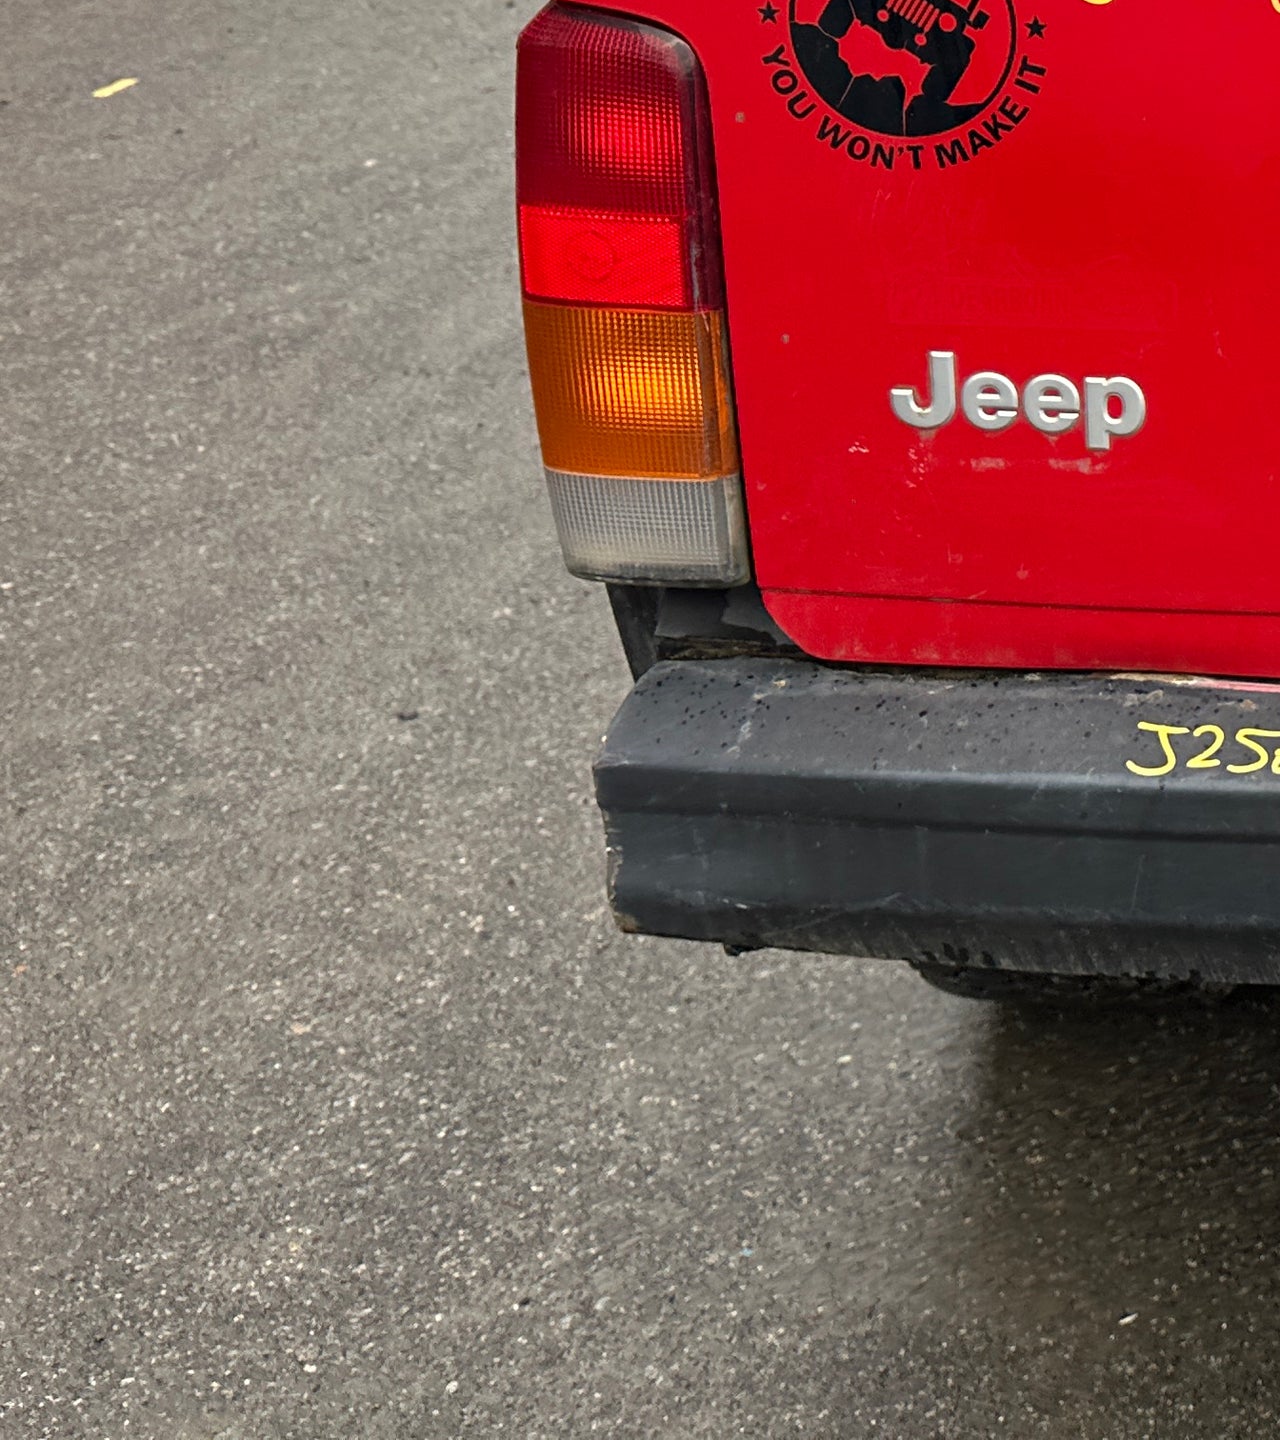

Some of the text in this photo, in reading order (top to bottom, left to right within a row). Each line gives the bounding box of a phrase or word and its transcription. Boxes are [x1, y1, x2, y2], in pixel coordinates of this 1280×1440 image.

[762, 44, 1047, 170] YOU WON'T MAKE IT
[890, 350, 1147, 450] Jeep
